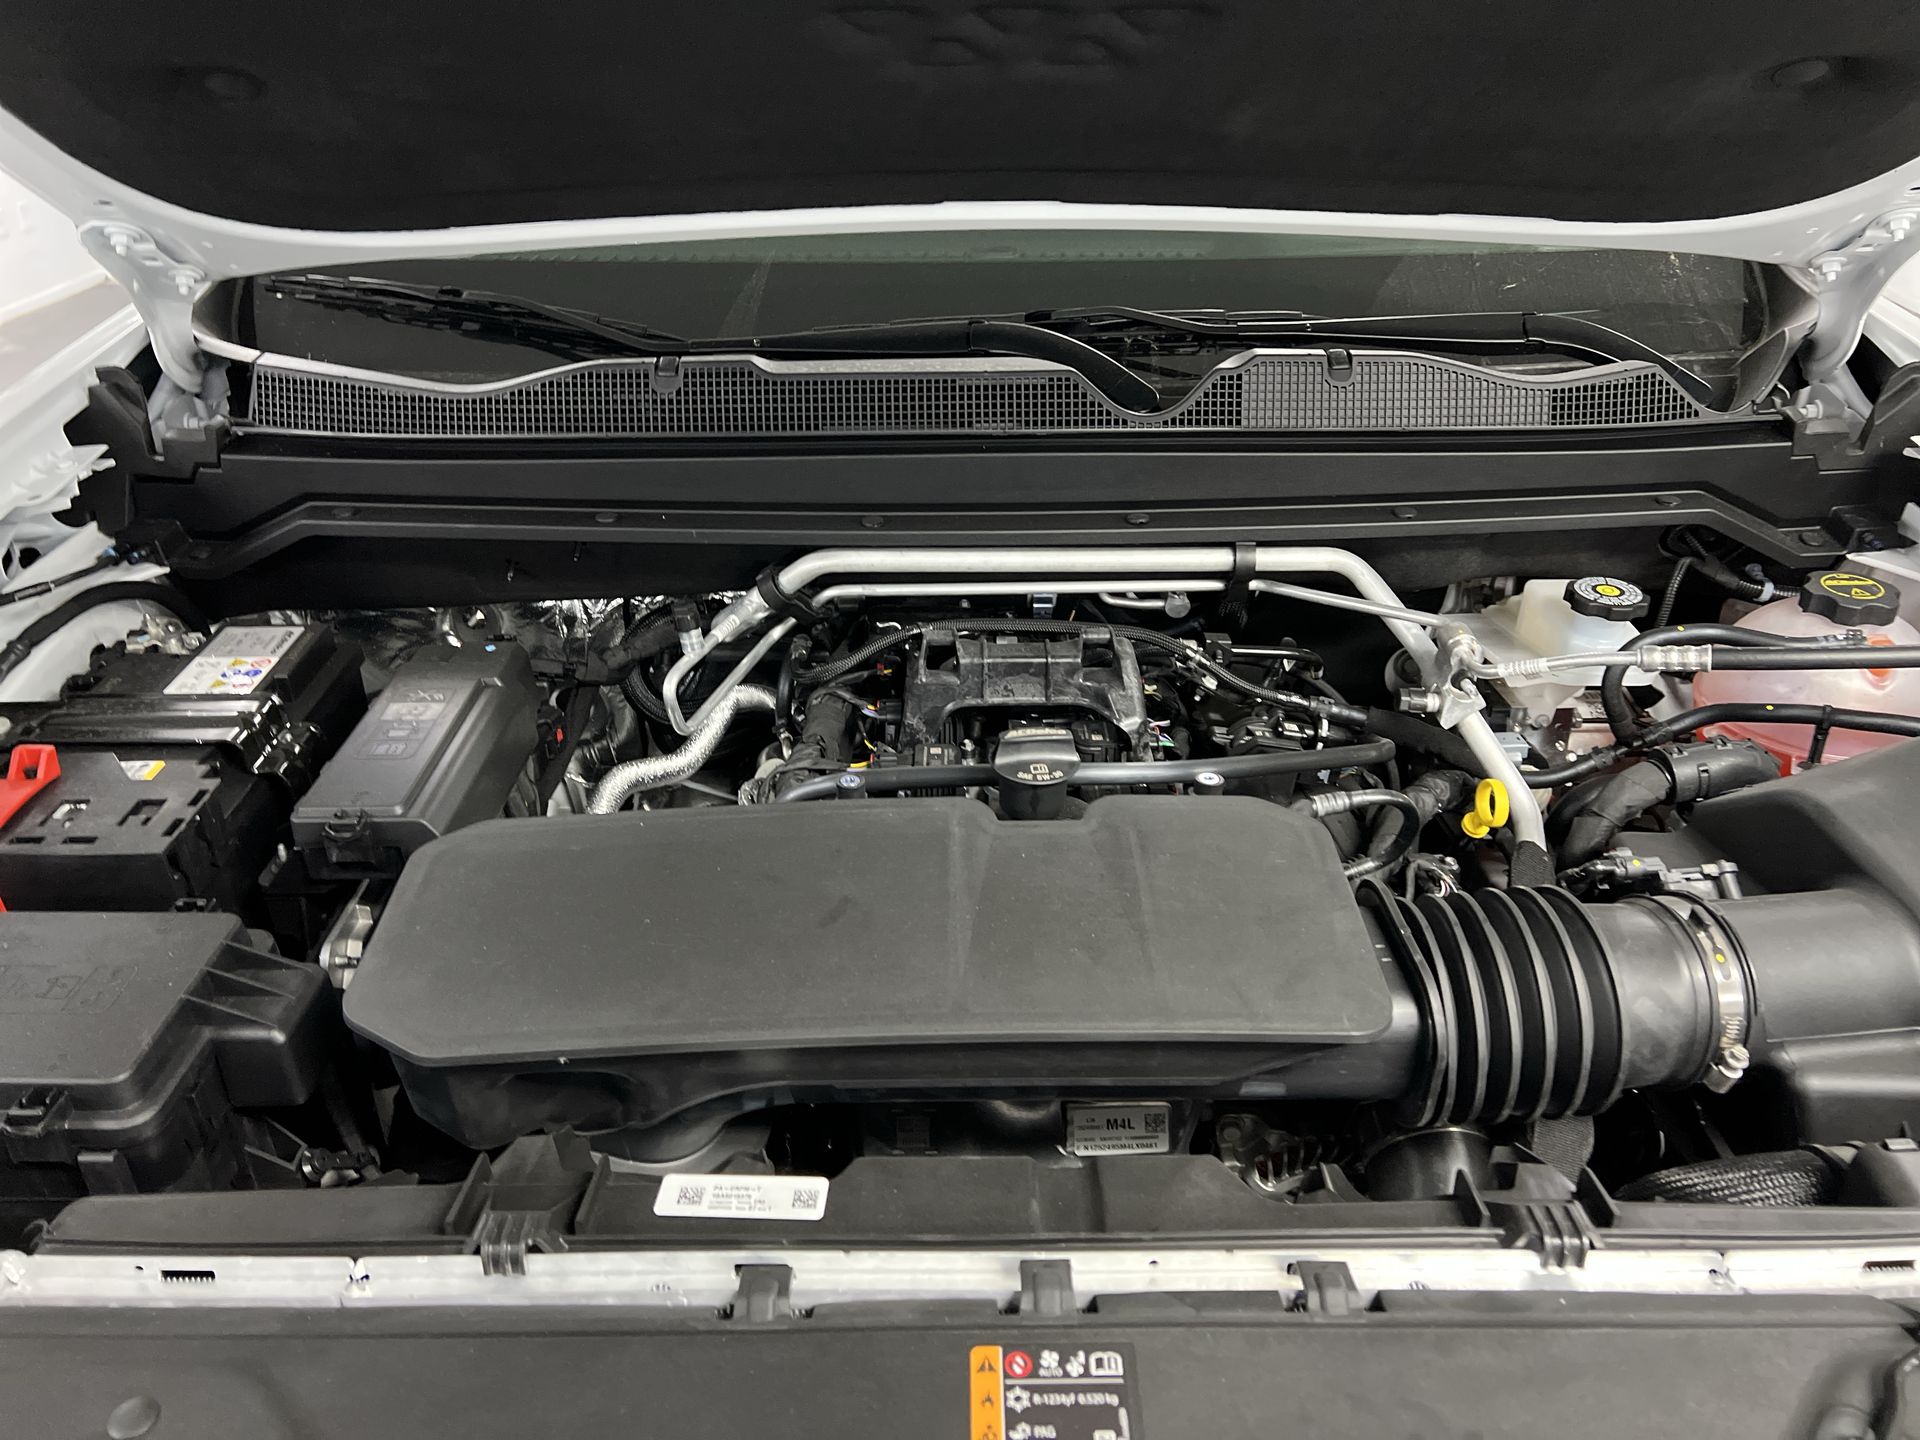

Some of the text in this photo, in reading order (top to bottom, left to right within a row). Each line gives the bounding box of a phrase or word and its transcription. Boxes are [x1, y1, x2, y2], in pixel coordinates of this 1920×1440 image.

[1004, 728, 1067, 739] ACDelco
[1016, 771, 1034, 781] SAE
[1106, 1117, 1135, 1131] M4L
